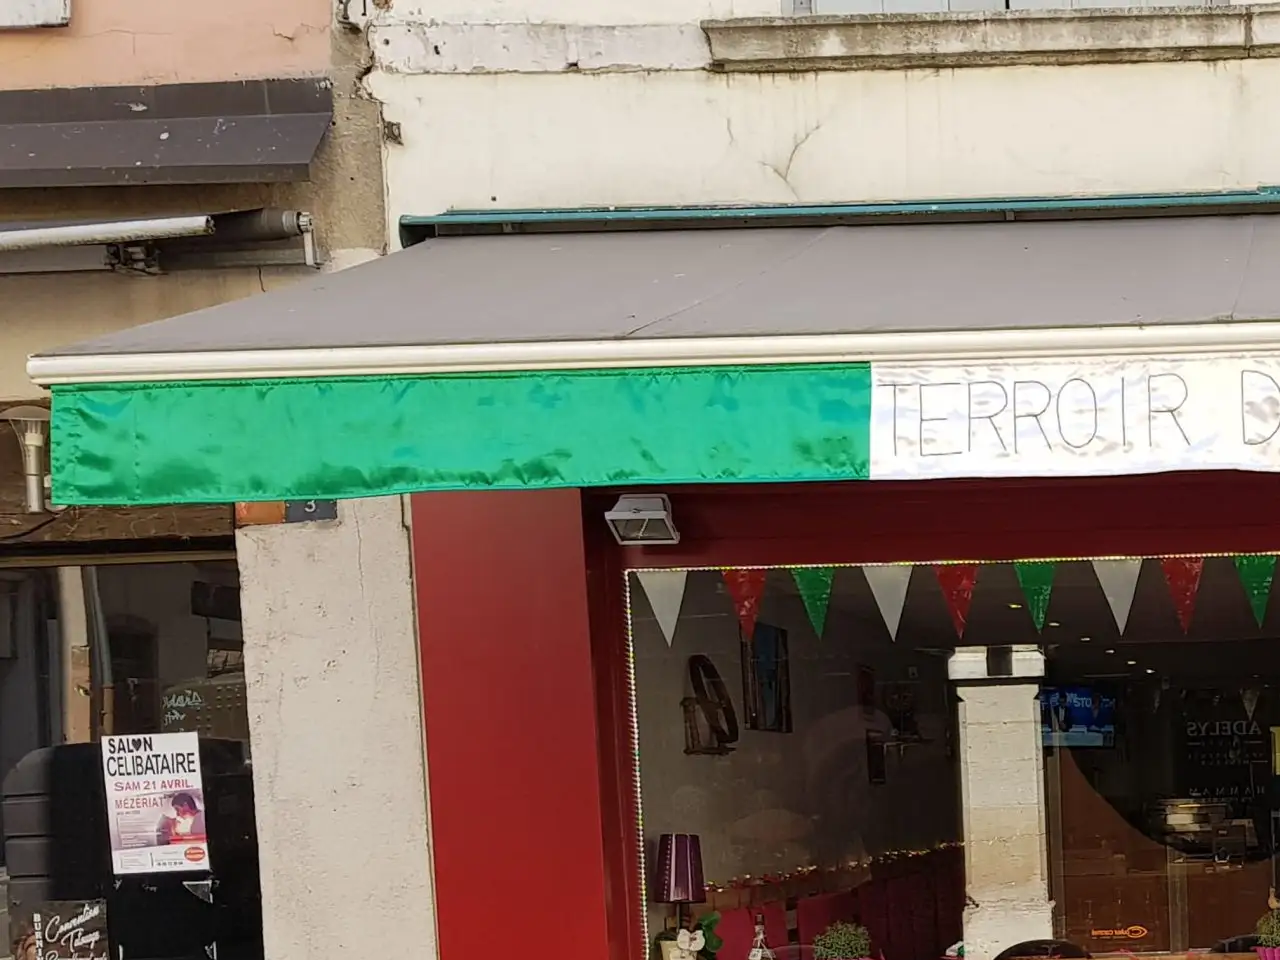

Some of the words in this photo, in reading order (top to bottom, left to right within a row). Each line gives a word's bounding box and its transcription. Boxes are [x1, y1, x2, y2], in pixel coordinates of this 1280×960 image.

[878, 373, 1191, 456] TERROIR
[106, 753, 197, 777] CELIBATAIRE
[114, 781, 141, 792] SAM
[143, 780, 157, 790] 21
